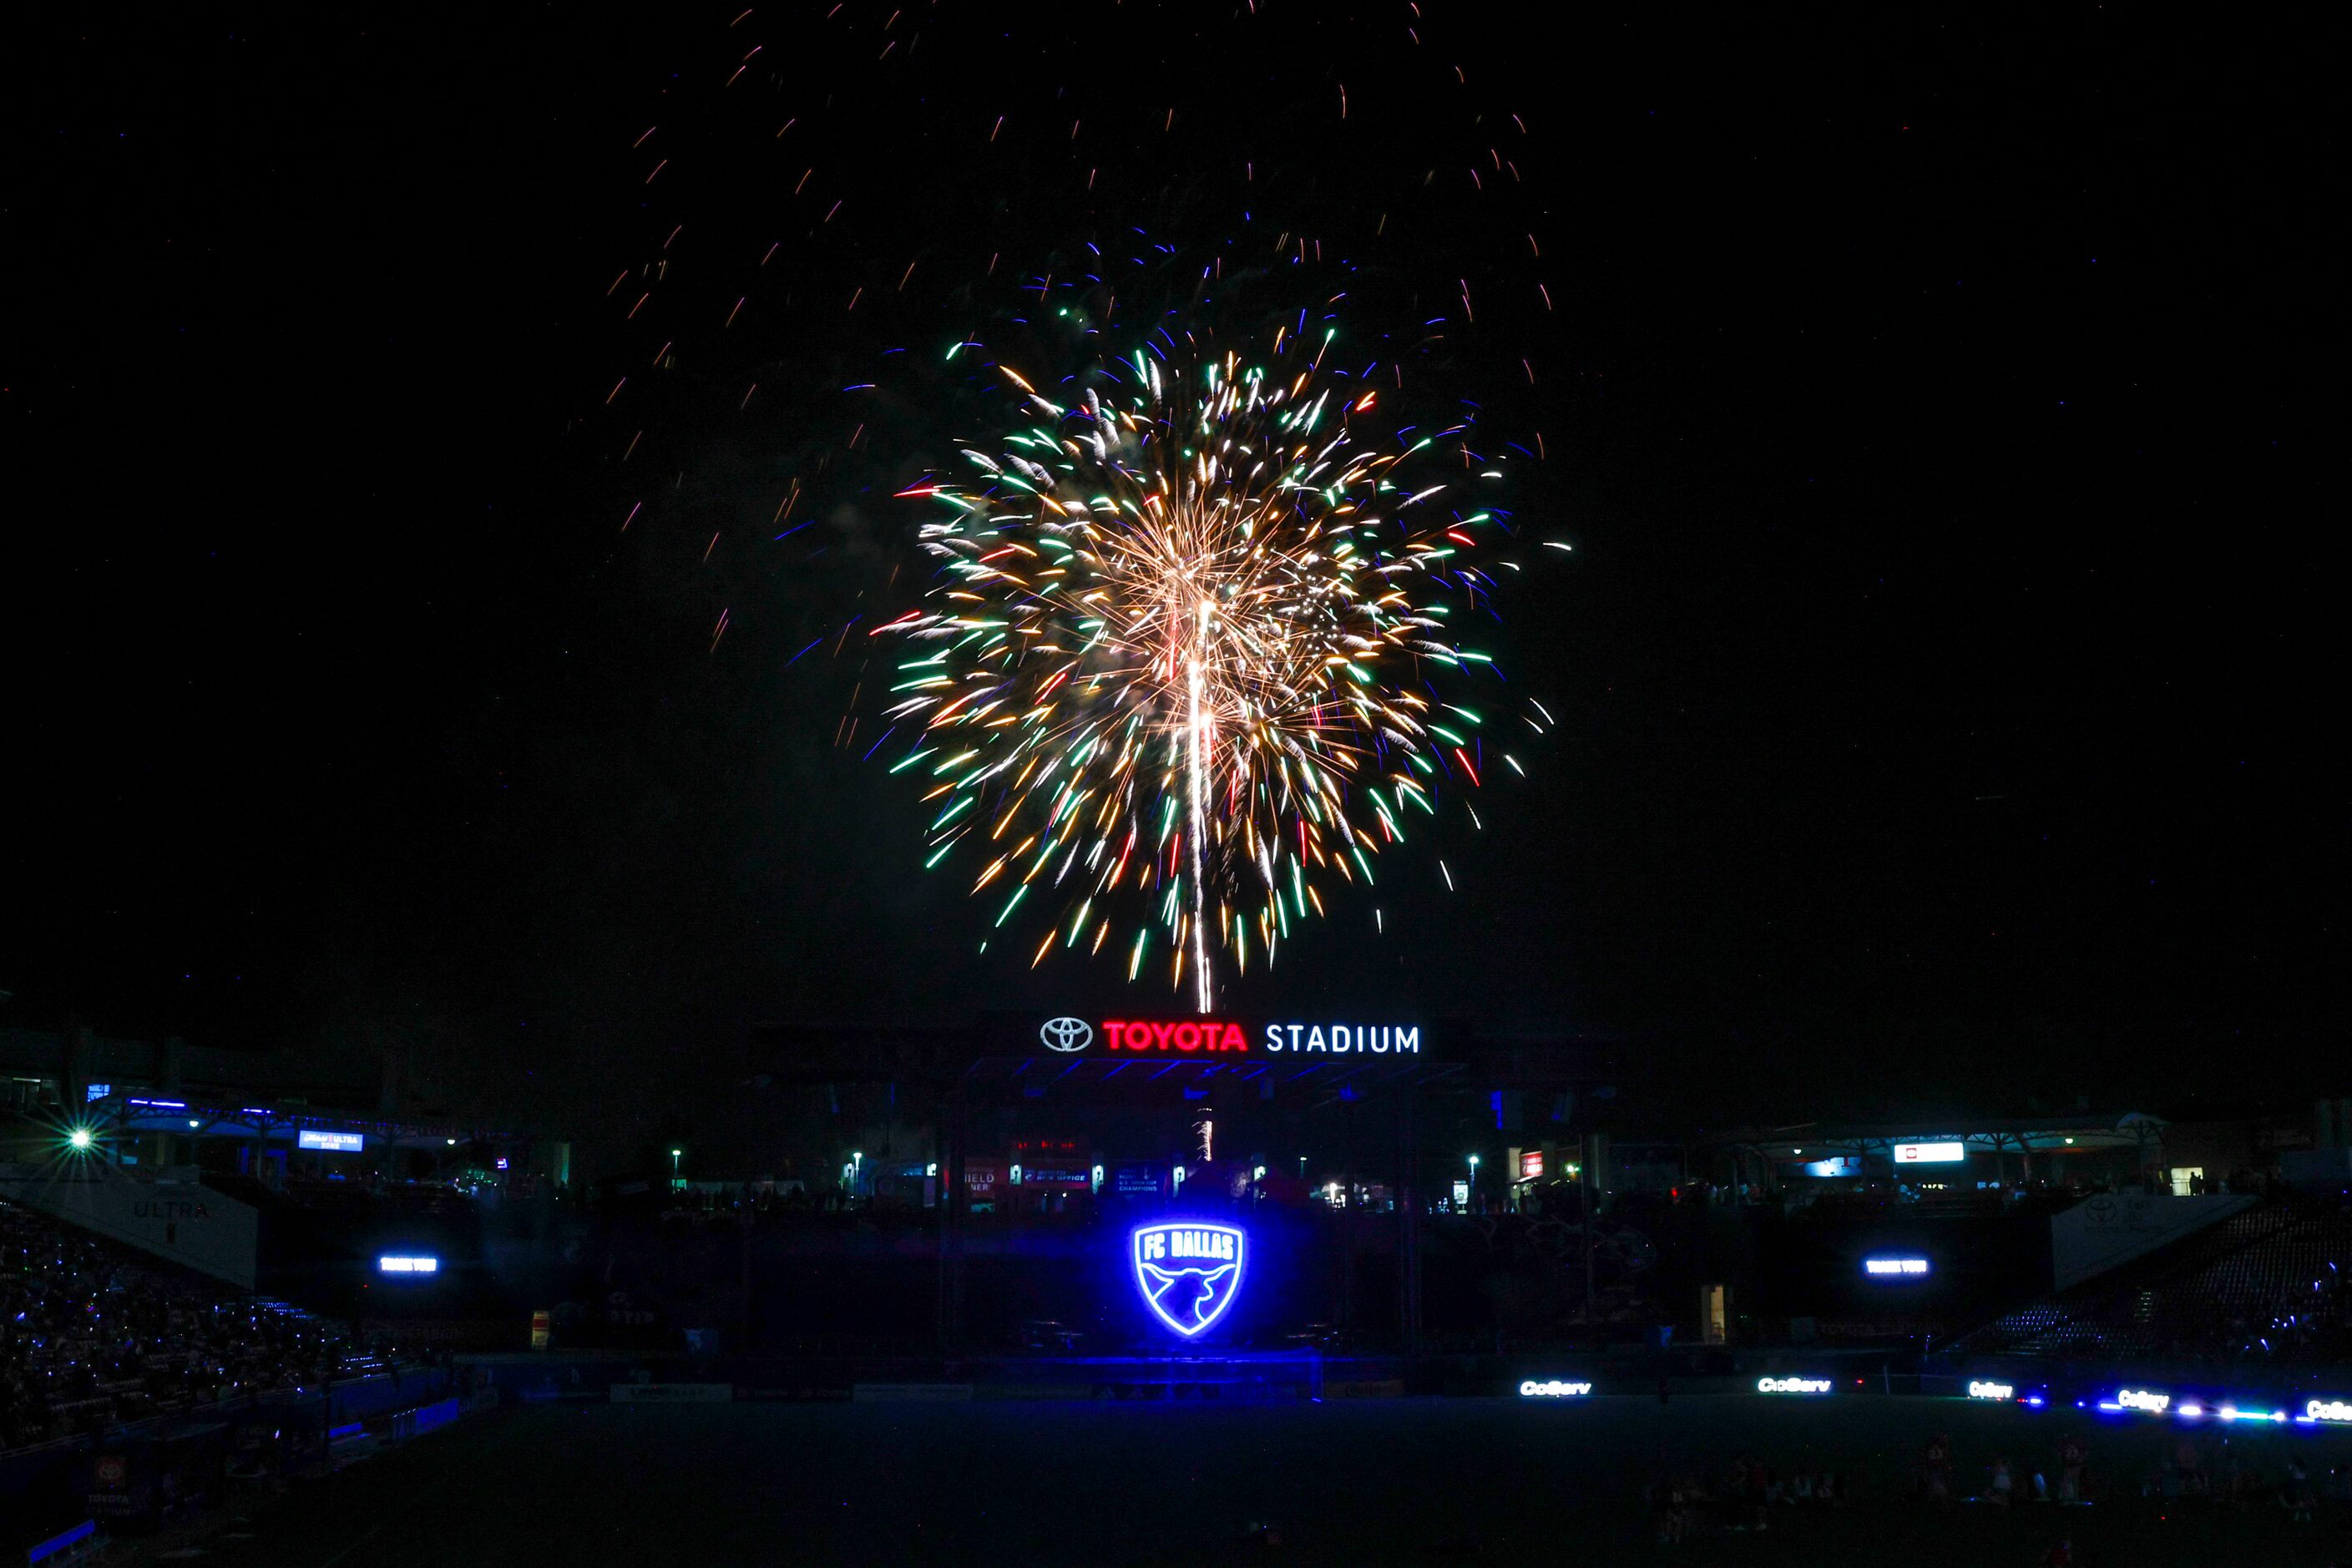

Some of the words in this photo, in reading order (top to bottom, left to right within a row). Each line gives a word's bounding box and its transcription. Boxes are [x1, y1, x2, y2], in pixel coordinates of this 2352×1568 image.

[1102, 1021, 1248, 1052] TOYOTA
[1267, 1024, 1419, 1054] STADIUM
[134, 1201, 209, 1218] ULTRA
[1144, 1233, 1166, 1260] FC
[1171, 1231, 1234, 1260] DALLAS
[1520, 1380, 1592, 1396] CoServ
